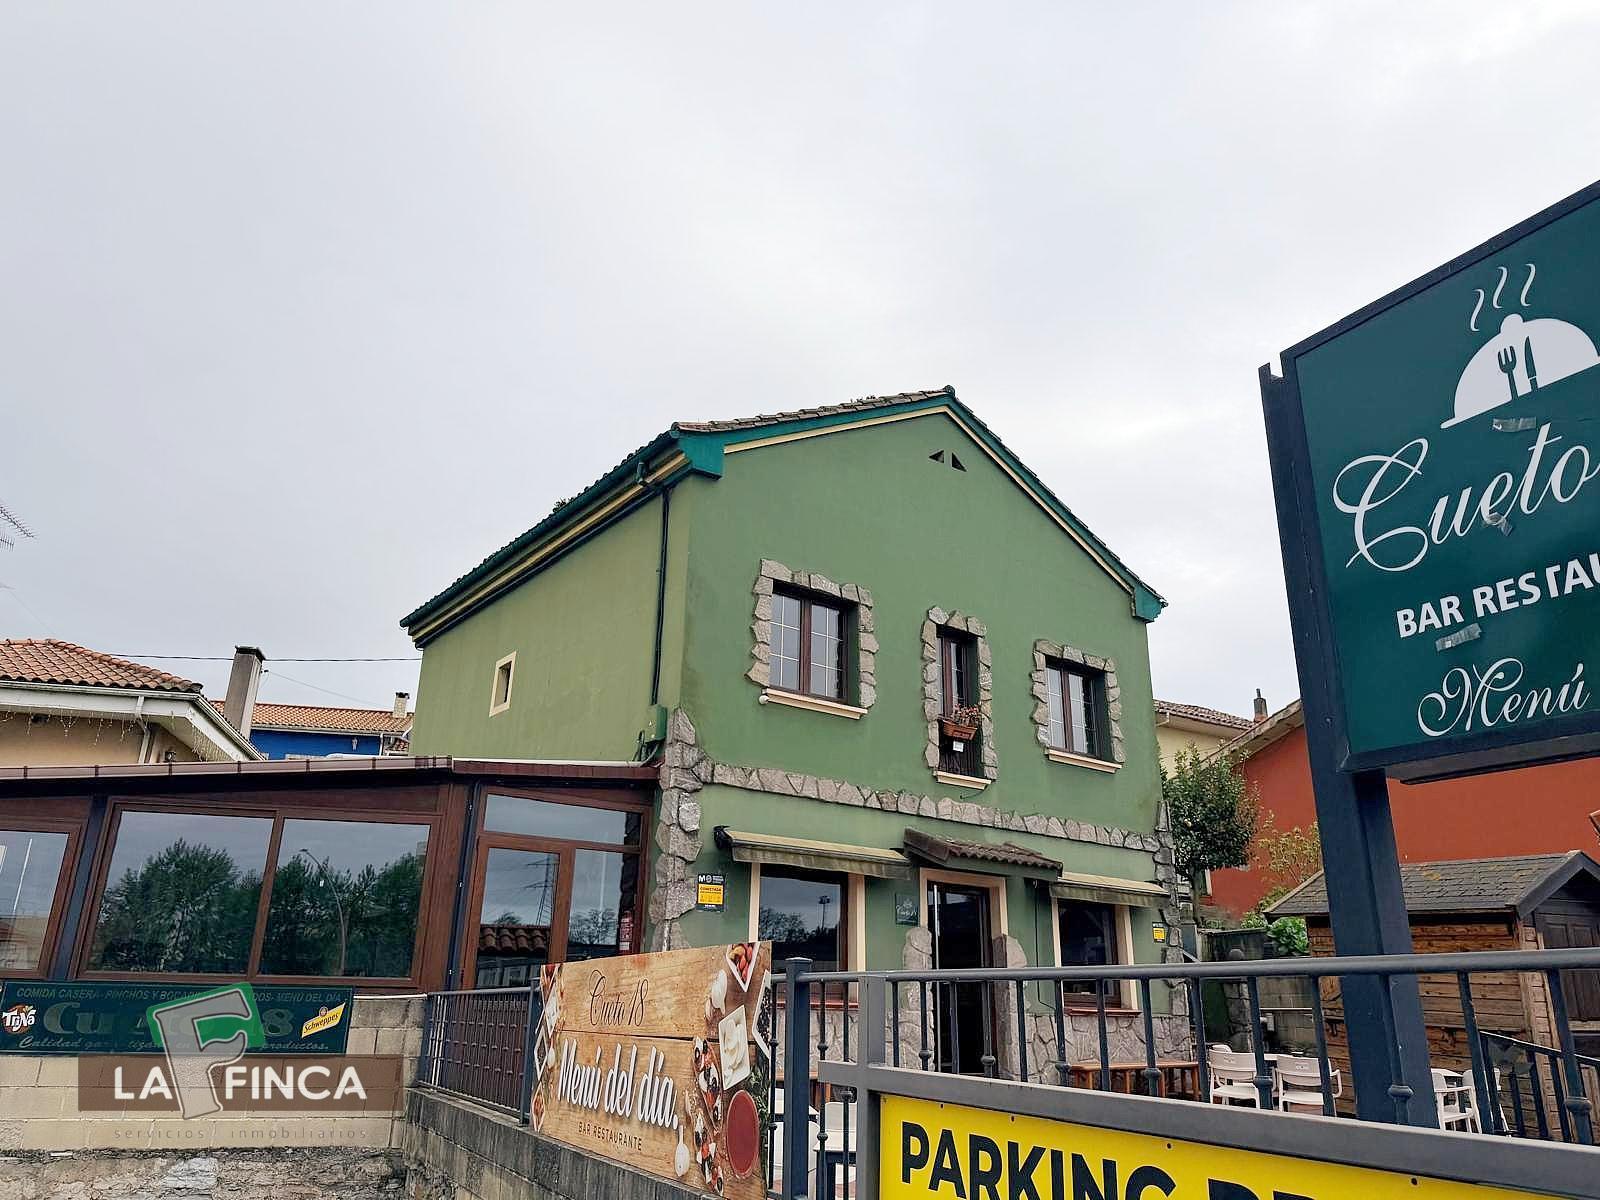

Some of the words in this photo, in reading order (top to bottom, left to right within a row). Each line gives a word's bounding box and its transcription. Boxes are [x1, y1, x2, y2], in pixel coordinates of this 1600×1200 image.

[1333, 422, 1600, 571] Cueto
[1396, 595, 1464, 638] BAR
[1417, 657, 1591, 737] Menú
[303, 1012, 339, 1034] Schweppes
[589, 969, 625, 1026] Cueto
[627, 978, 649, 1027] 18
[558, 1039, 604, 1109] Menú
[605, 1043, 637, 1117] del
[578, 1120, 591, 1135] BAR
[593, 1125, 642, 1151] RESTAURANTE
